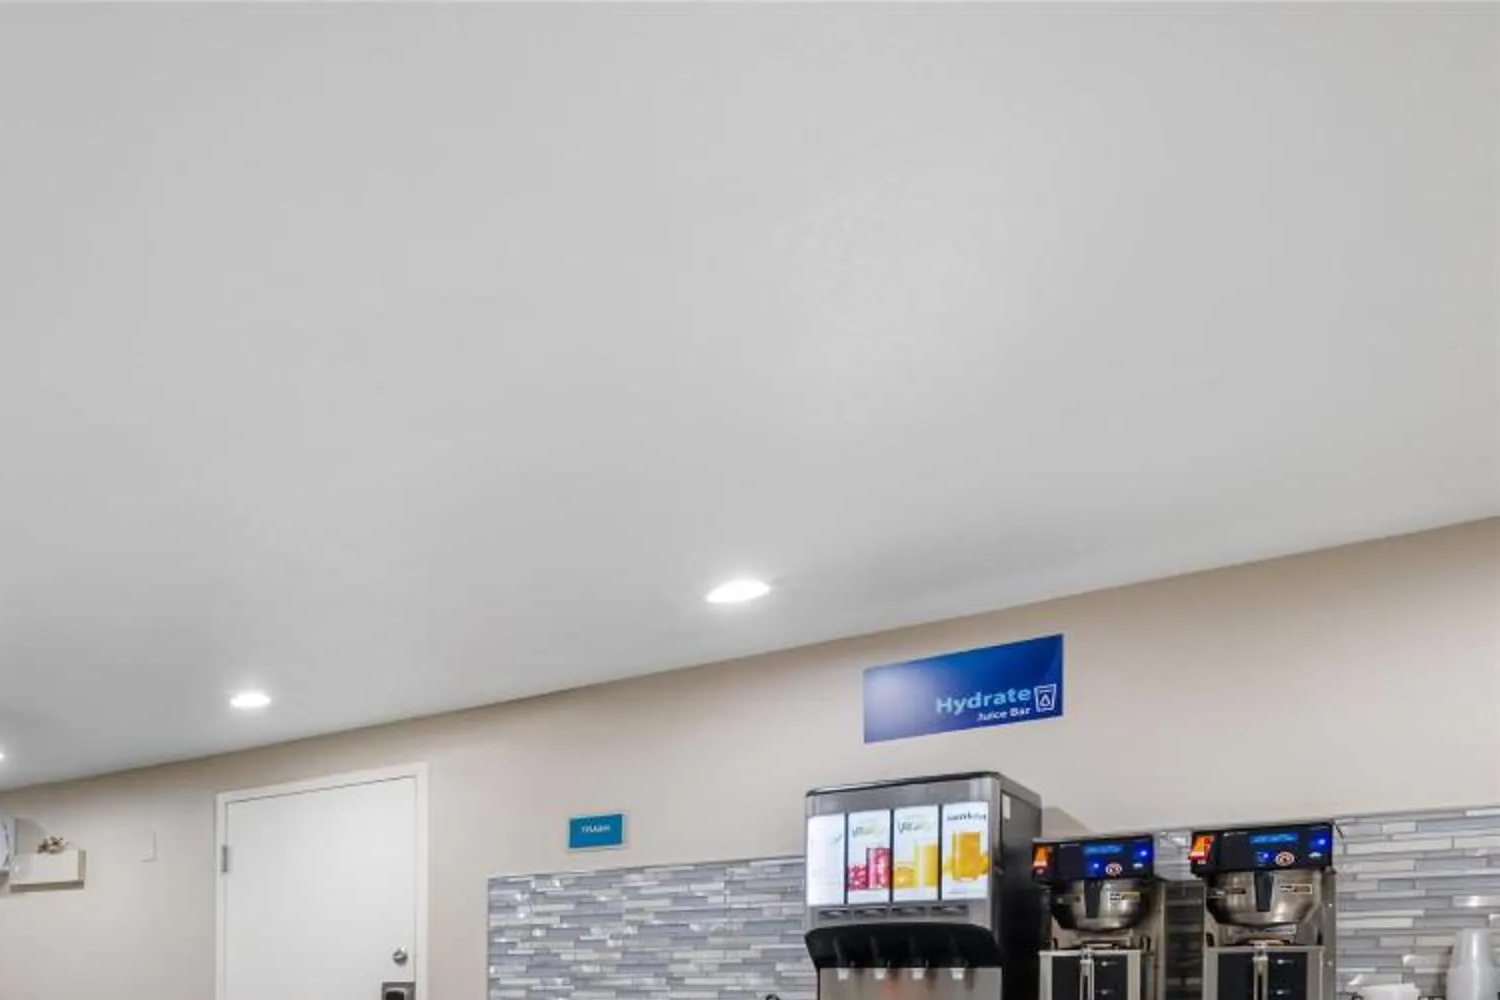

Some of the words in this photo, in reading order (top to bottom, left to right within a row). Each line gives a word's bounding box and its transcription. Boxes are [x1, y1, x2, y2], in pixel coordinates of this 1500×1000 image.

[936, 688, 1032, 716] Hydrate
[977, 711, 1008, 721] Juice
[1009, 707, 1032, 717] Bar
